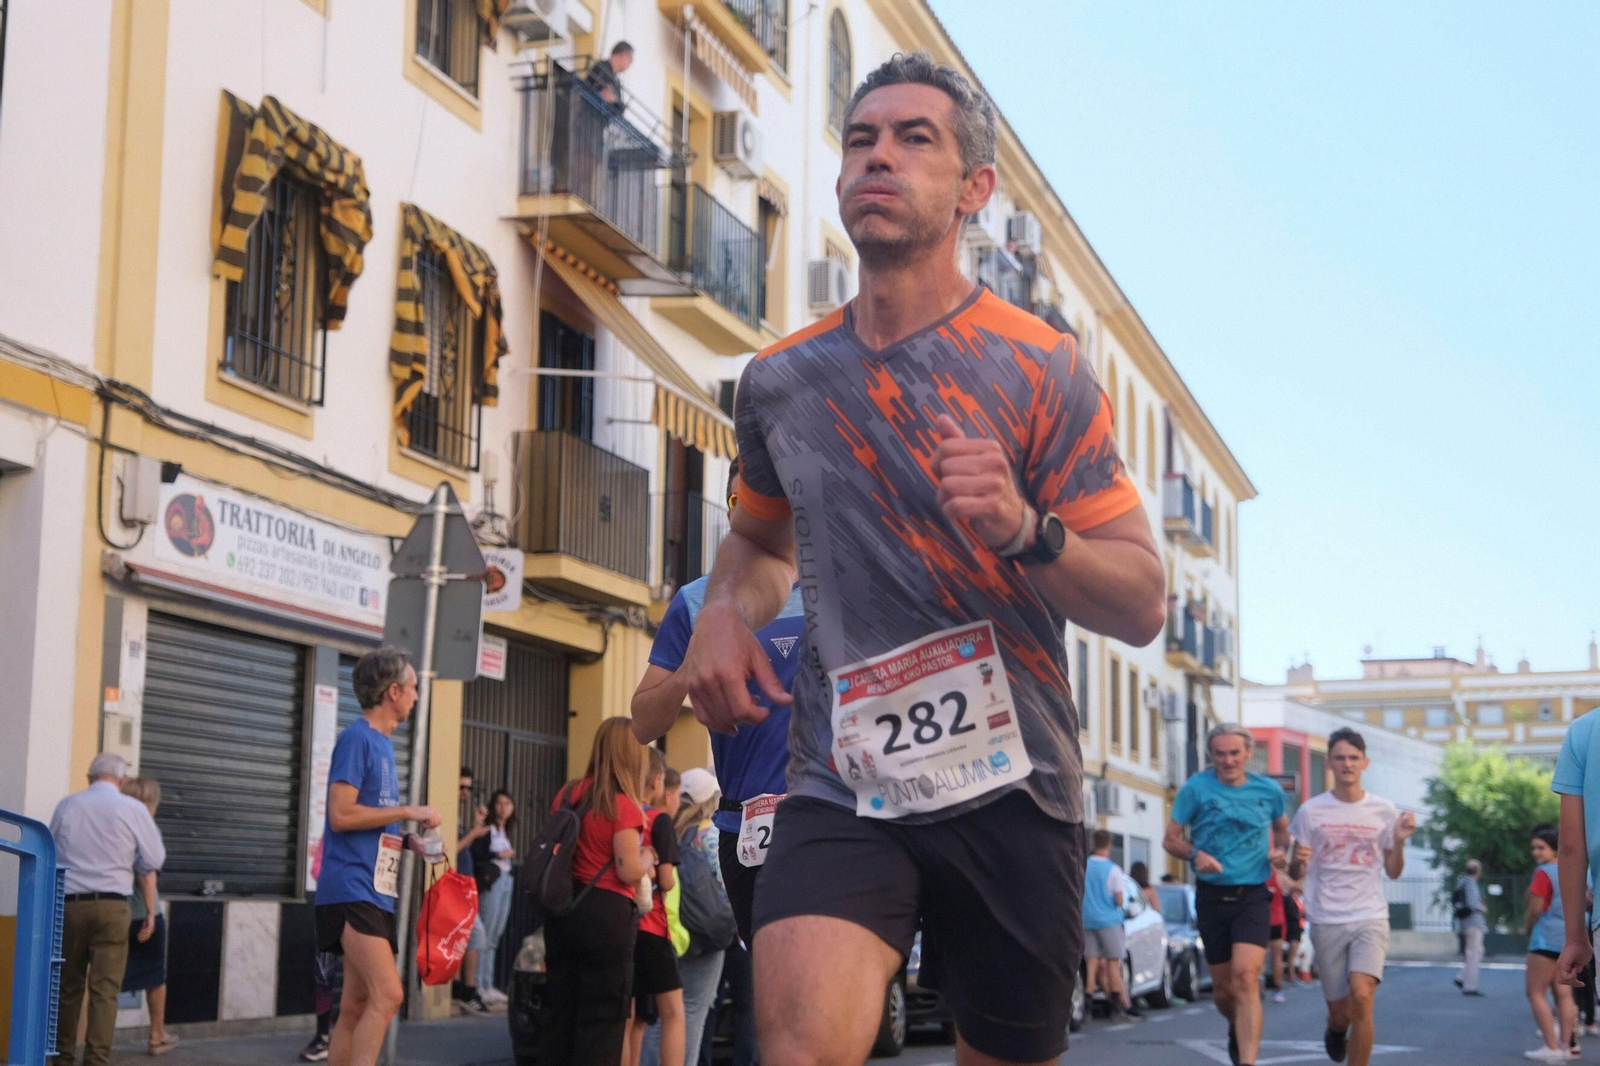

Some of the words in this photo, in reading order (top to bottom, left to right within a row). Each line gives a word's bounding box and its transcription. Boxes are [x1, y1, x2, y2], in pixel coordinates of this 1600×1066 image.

[217, 498, 317, 551] TRATTORIA
[322, 539, 336, 556] DI
[339, 545, 382, 570] ANGELO
[237, 535, 268, 556] pizzas
[271, 543, 318, 569] artesanas
[788, 477, 819, 634] warriors
[875, 690, 976, 755] 282
